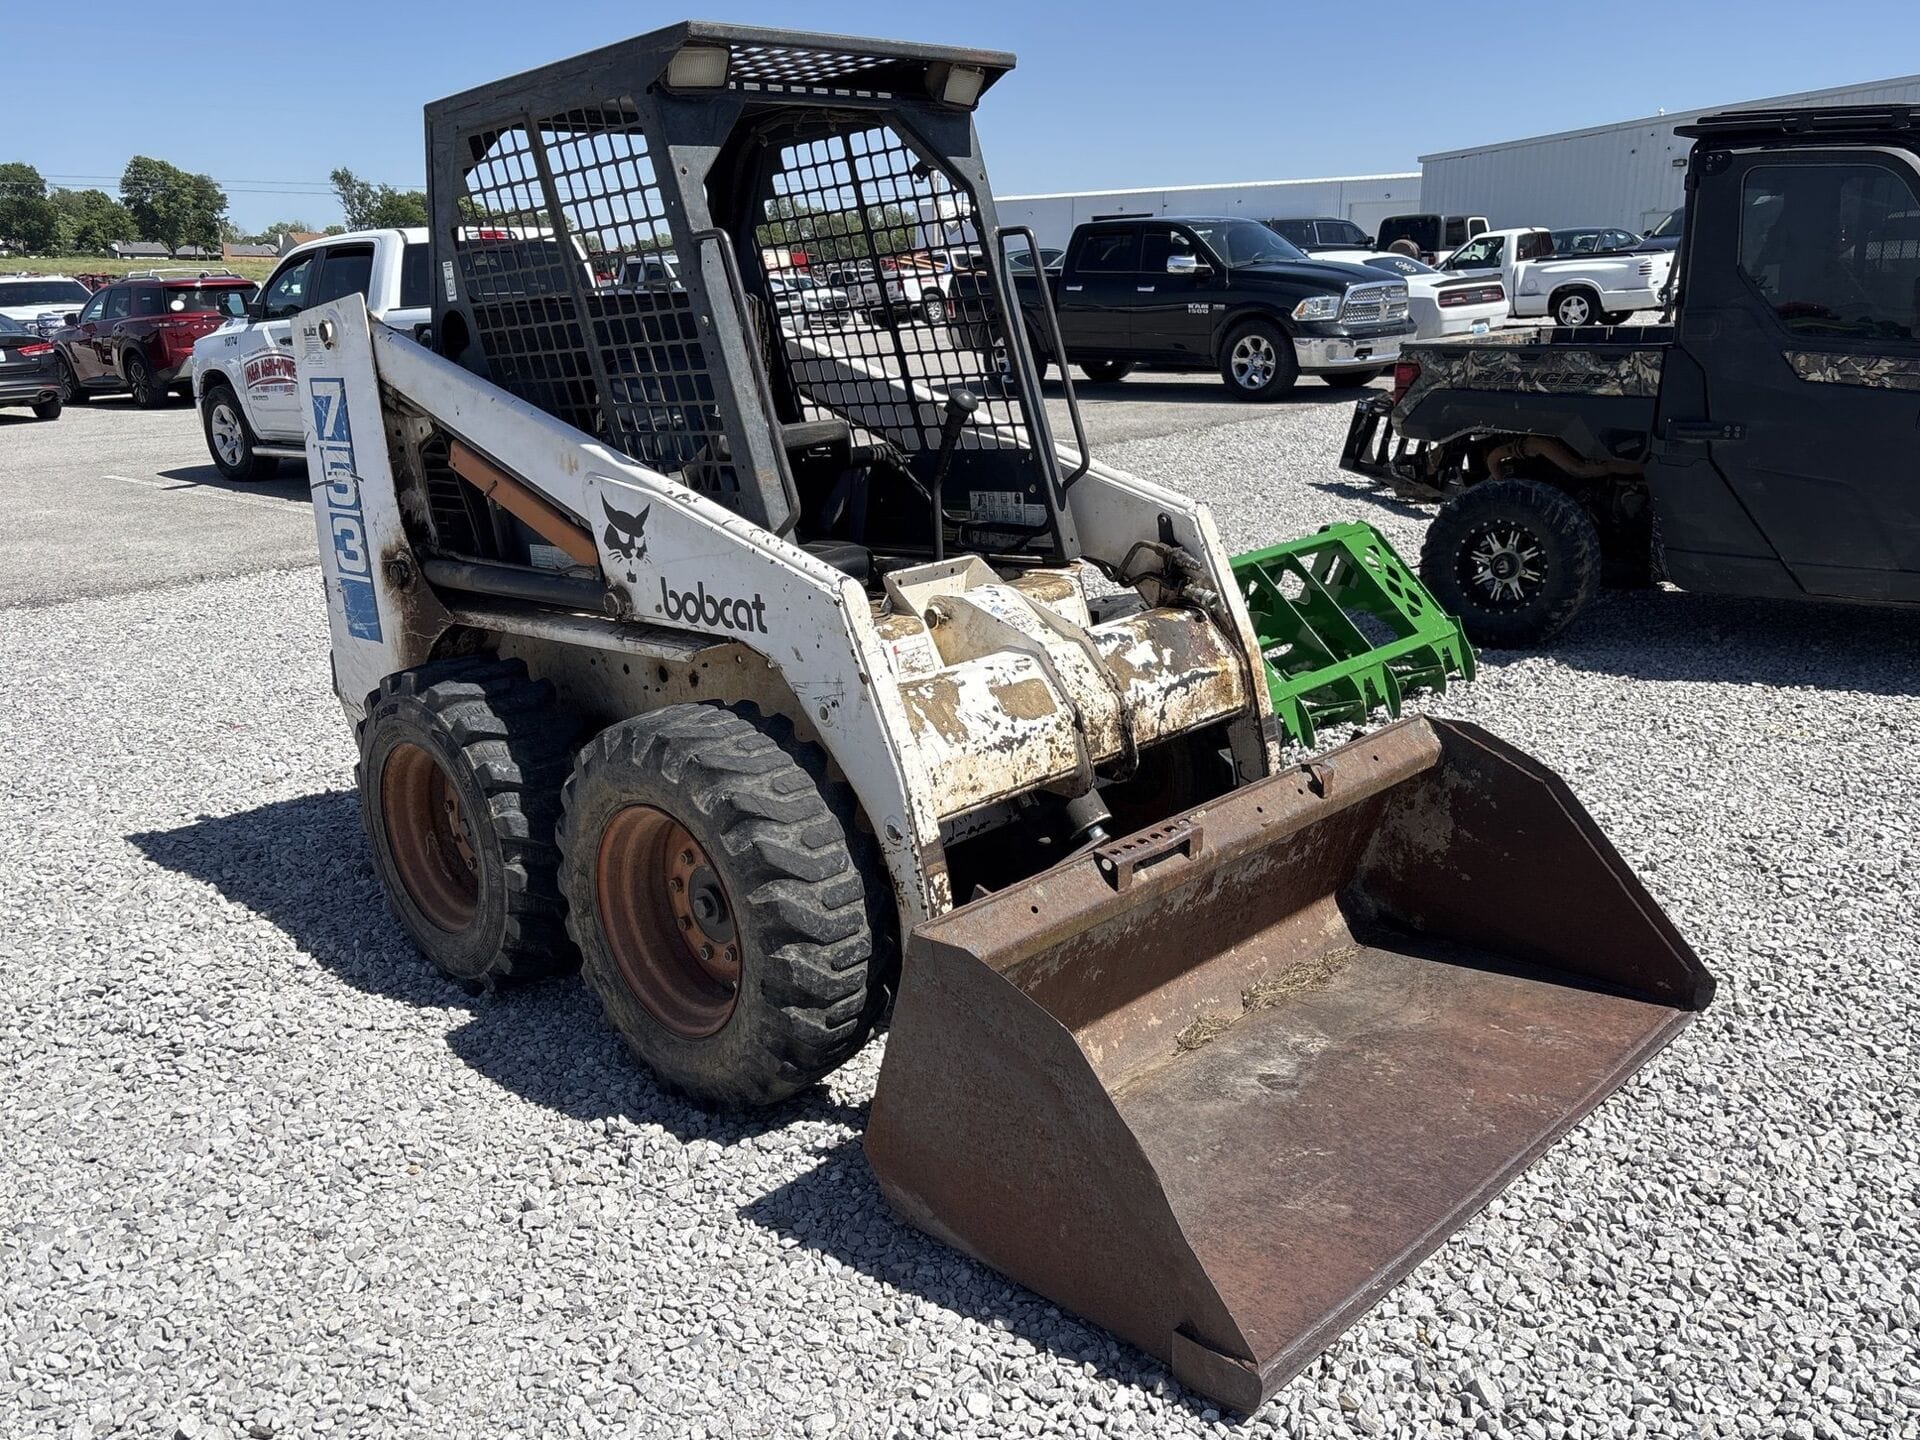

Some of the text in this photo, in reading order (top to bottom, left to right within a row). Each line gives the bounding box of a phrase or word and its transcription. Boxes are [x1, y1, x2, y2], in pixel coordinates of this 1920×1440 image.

[224, 336, 238, 347] 1074
[261, 357, 298, 379] AGRI-POWE
[1473, 371, 1609, 386] RANGER
[311, 380, 368, 574] 753
[660, 576, 768, 634] bobcat
